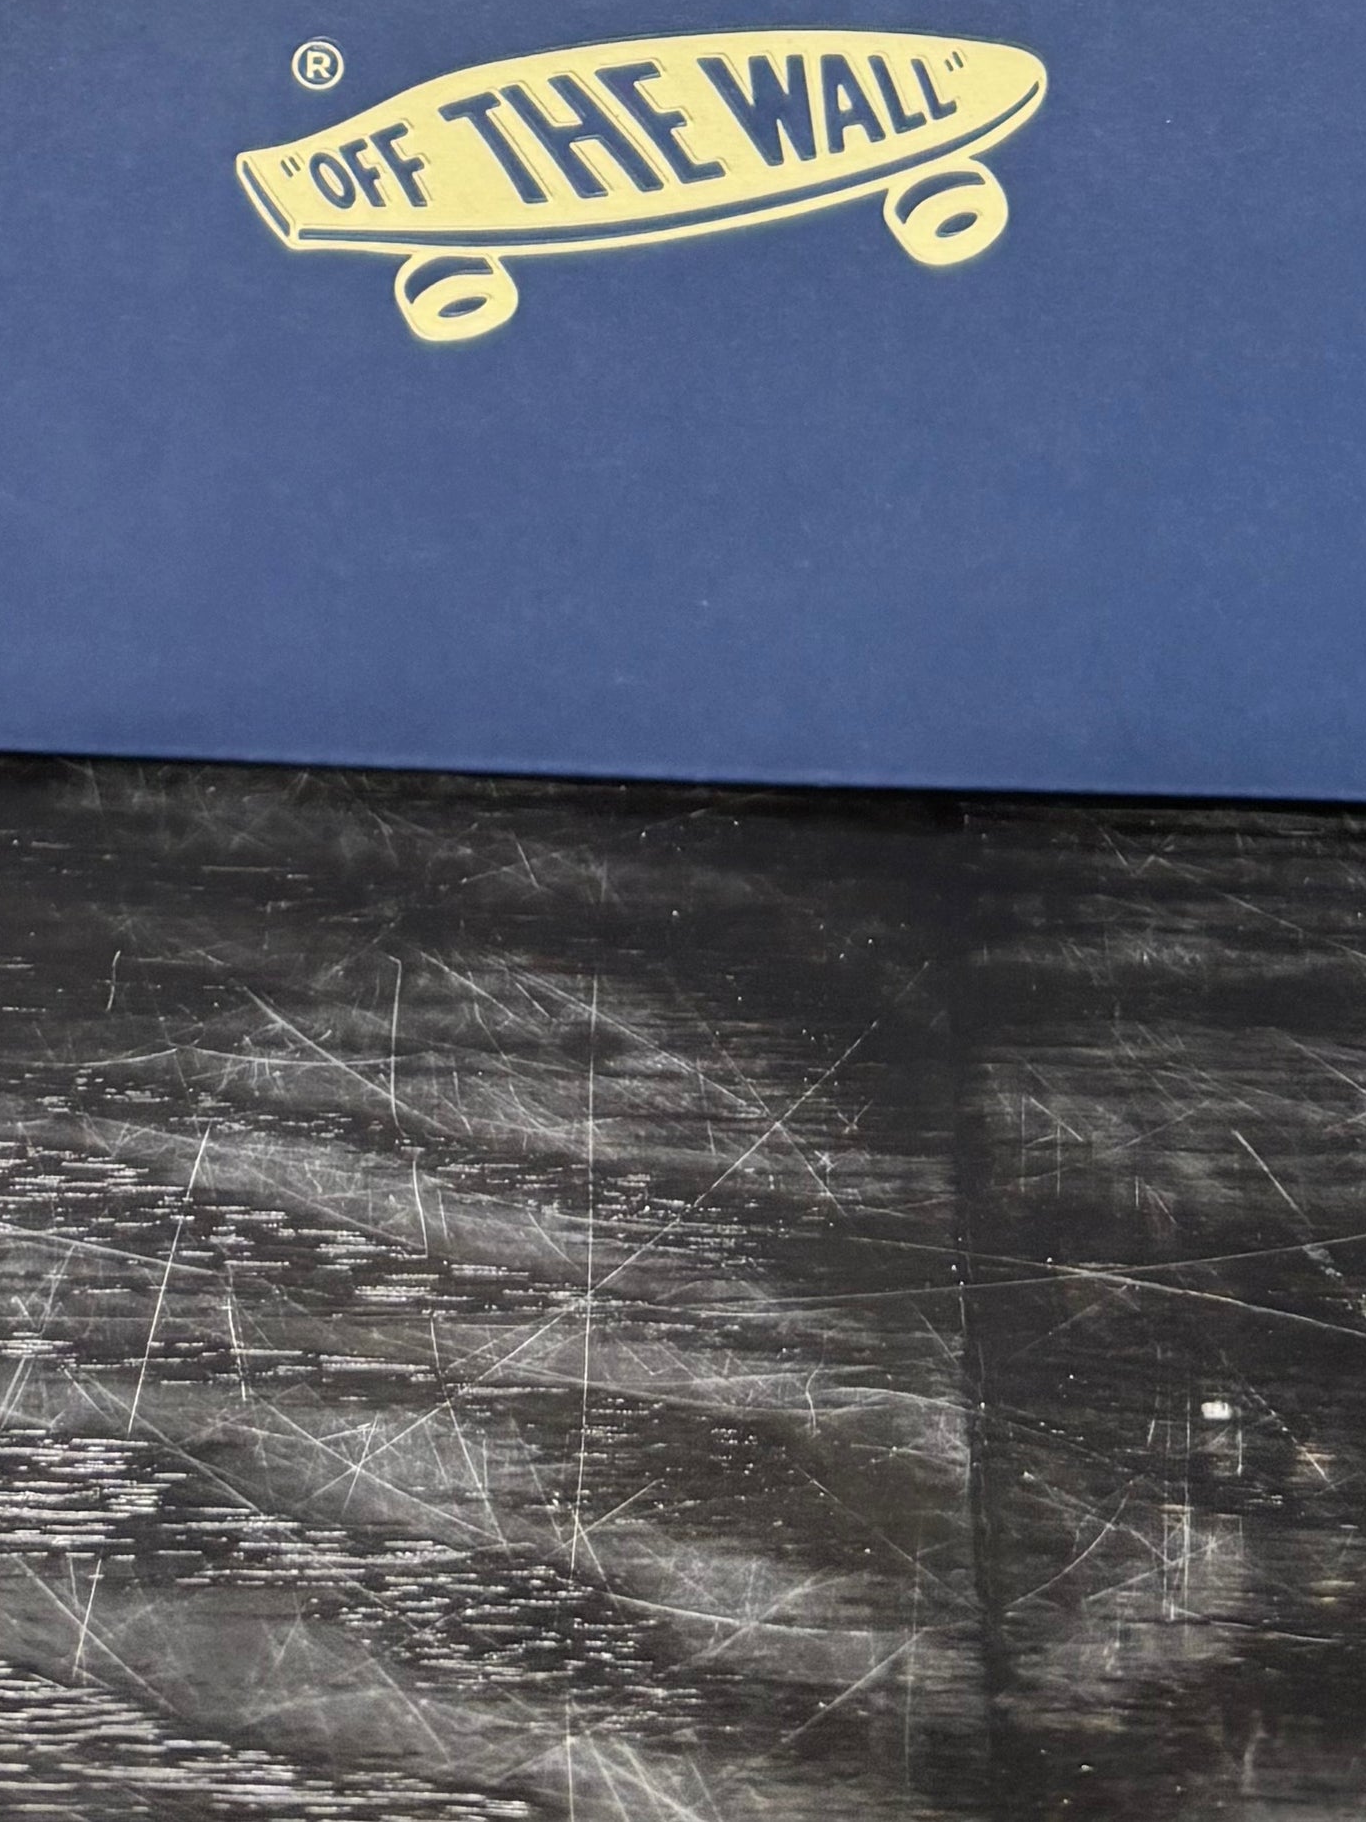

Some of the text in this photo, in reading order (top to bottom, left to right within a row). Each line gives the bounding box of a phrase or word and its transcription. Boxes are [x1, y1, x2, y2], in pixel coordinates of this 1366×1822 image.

[281, 51, 965, 209] "OFF THE WALL"
